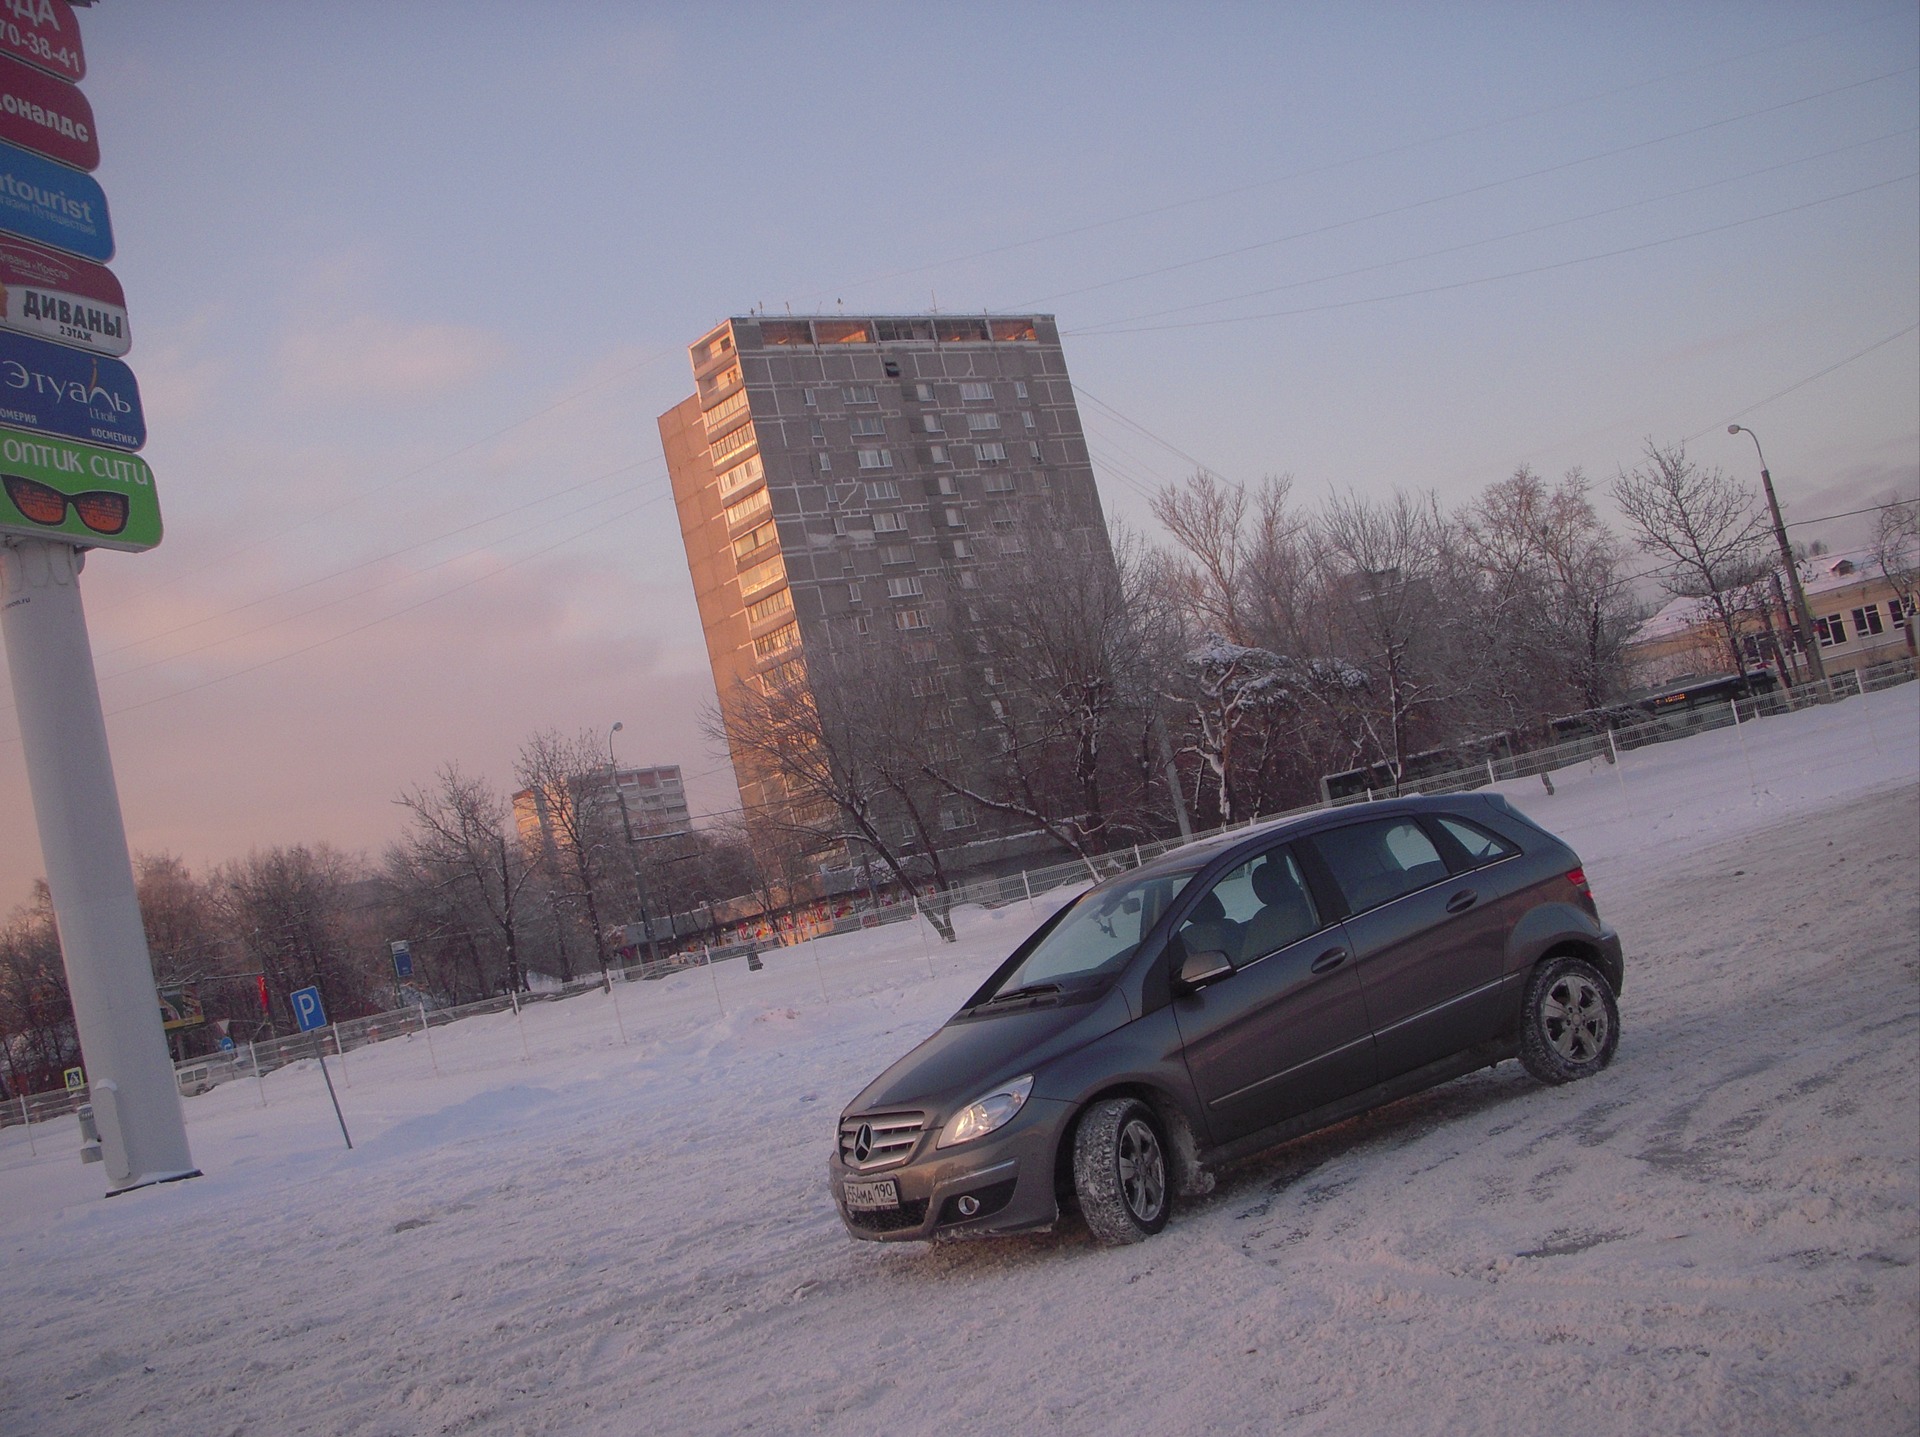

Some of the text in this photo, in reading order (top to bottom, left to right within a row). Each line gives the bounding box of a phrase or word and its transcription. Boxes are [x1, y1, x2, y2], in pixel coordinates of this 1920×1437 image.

[5, 0, 60, 31] ДА
[0, 93, 89, 142] оналдс
[23, 289, 122, 339] ДИВАНЫ
[60, 325, 92, 342] 2 ЭТАЖ
[91, 427, 138, 445] КОСМЕТИКА
[298, 994, 315, 1026] P
[875, 1183, 893, 1198] 190
